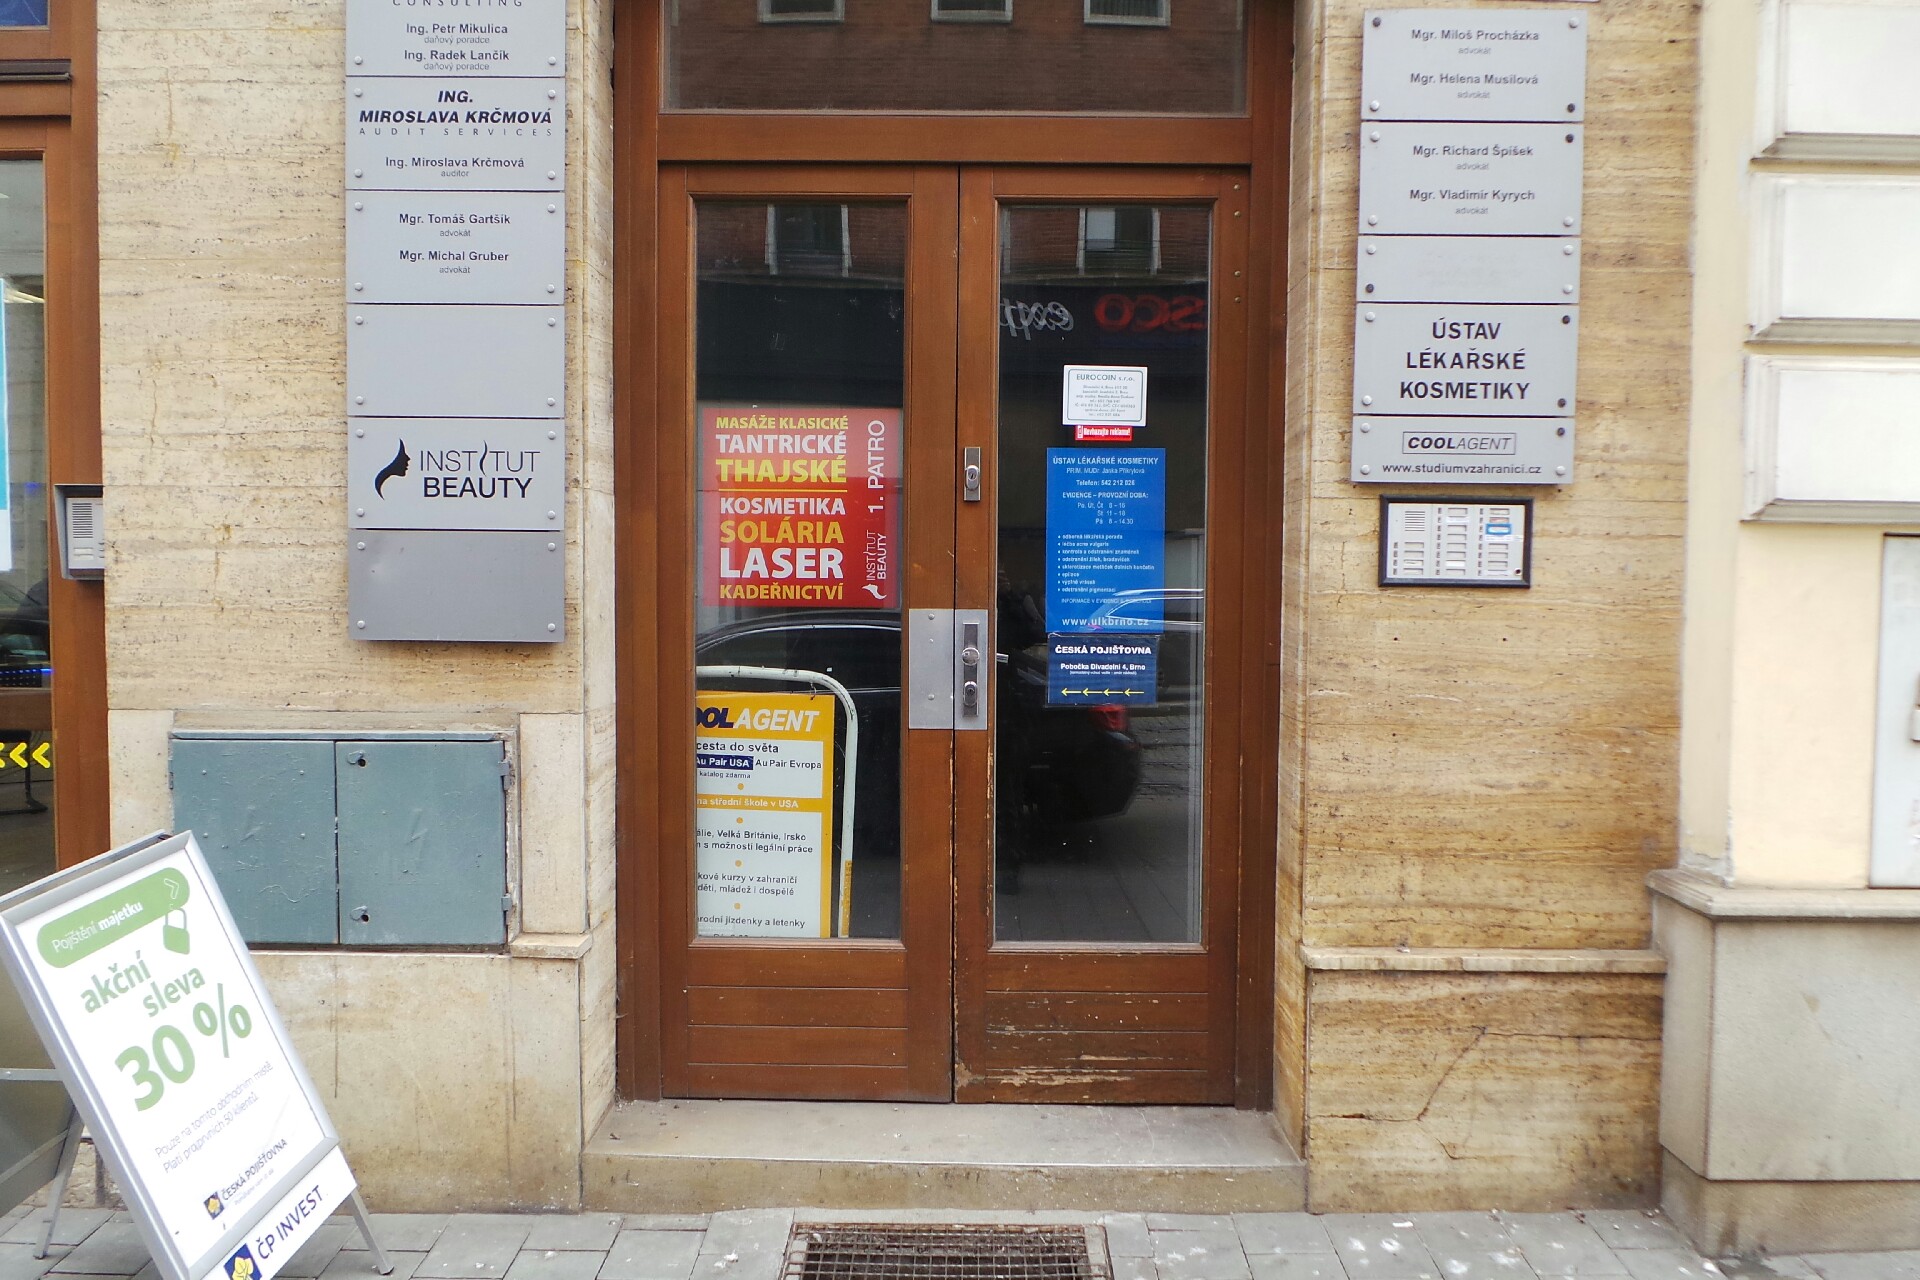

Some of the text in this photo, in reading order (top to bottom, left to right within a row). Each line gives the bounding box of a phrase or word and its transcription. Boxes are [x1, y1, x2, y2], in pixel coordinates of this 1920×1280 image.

[406, 23, 509, 36] Ing. Petr Mikulica
[1411, 29, 1539, 42] Mgr. Miloš Procházka
[424, 35, 490, 45] daňový poradce
[404, 50, 427, 63] Ing.
[430, 50, 467, 61] Radek
[423, 62, 490, 71] daňový poradce
[1409, 73, 1538, 85] Mgr. Helena Musilová
[437, 90, 474, 103] ING.
[359, 107, 553, 124] MIROSLAVA KRČMOVÁ
[359, 128, 553, 138] AUDIT SERVICES
[1412, 145, 1438, 158] Mgr.
[1442, 145, 1488, 157] Richard
[385, 156, 525, 169] Ing. Miroslava Krčmová
[440, 169, 470, 178] auditor
[1409, 189, 1536, 203] Mgr. Vladimír Kyrych
[399, 213, 425, 227] Mgr.
[427, 213, 466, 225] Tomáš
[439, 229, 472, 238] advokát
[399, 250, 510, 263] Mgr. Michal Gruber
[439, 265, 471, 275] advokát
[1432, 316, 1502, 340] ÚSTAV
[1406, 347, 1527, 370] LÉKAŘSKÉ
[1076, 373, 1117, 381] EUROCOIN
[1399, 381, 1531, 400] KOSMETIKY
[715, 414, 849, 430] MASÁŽE KLASICKÉ
[715, 430, 847, 454] TANTRICKÉ
[1407, 435, 1513, 451] COOLAGENT
[419, 440, 542, 477] INSTITUT
[1052, 455, 1159, 465] ÚSTAV LÉKAŘSKÉ KOSMETIKY
[715, 455, 847, 483] THAJSKÉ
[866, 419, 886, 514] 1. PATRO
[1382, 463, 1543, 475] www.studiumvzahranici.cz
[422, 477, 533, 499] BEAUTY
[720, 497, 846, 515] KOSMETIKA
[719, 516, 845, 544] SOLÁRIA
[863, 529, 877, 581] INSTITUT
[877, 533, 888, 580] BEAUTY
[720, 547, 845, 579] LASER
[719, 582, 844, 600] KADEŘNICTVÍ
[1061, 616, 1150, 627] www.ulkbrno.cz
[1054, 644, 1153, 655] ČESKÁ POJIŠŤOVNA
[1060, 662, 1089, 671] Pobočka
[696, 742, 780, 754] cesta do světa
[708, 757, 728, 767] Pair
[729, 758, 750, 768] USA
[755, 759, 767, 768] Au
[769, 759, 789, 769] Pair
[789, 760, 823, 771] Evropa
[699, 770, 752, 780] katalog zdarma
[709, 797, 742, 807] střední
[744, 798, 769, 808] škole
[778, 800, 800, 809] USA
[717, 829, 742, 840] Velká
[743, 830, 782, 842] Británie,
[783, 832, 808, 842] Irsko
[755, 842, 786, 855] legální
[787, 844, 814, 857] práce
[721, 873, 746, 884] kurzy
[756, 874, 799, 886] zahraničí
[719, 884, 752, 896] mládež
[758, 885, 796, 899] dospělé
[51, 901, 144, 953] Pojištění majetku
[697, 914, 724, 925] rodní
[724, 915, 764, 929] jízdenky
[772, 917, 807, 930] letenky
[80, 949, 151, 1013] akční
[142, 967, 206, 1018] sleva
[154, 1135, 181, 1158] Pouze
[180, 1126, 192, 1137] na
[191, 1106, 217, 1131] tomto
[221, 1173, 247, 1201] ČESKÁ
[245, 1138, 289, 1181] POJIŠŤOVNA
[256, 1230, 276, 1260] ČP
[276, 1185, 324, 1241] INVEST
